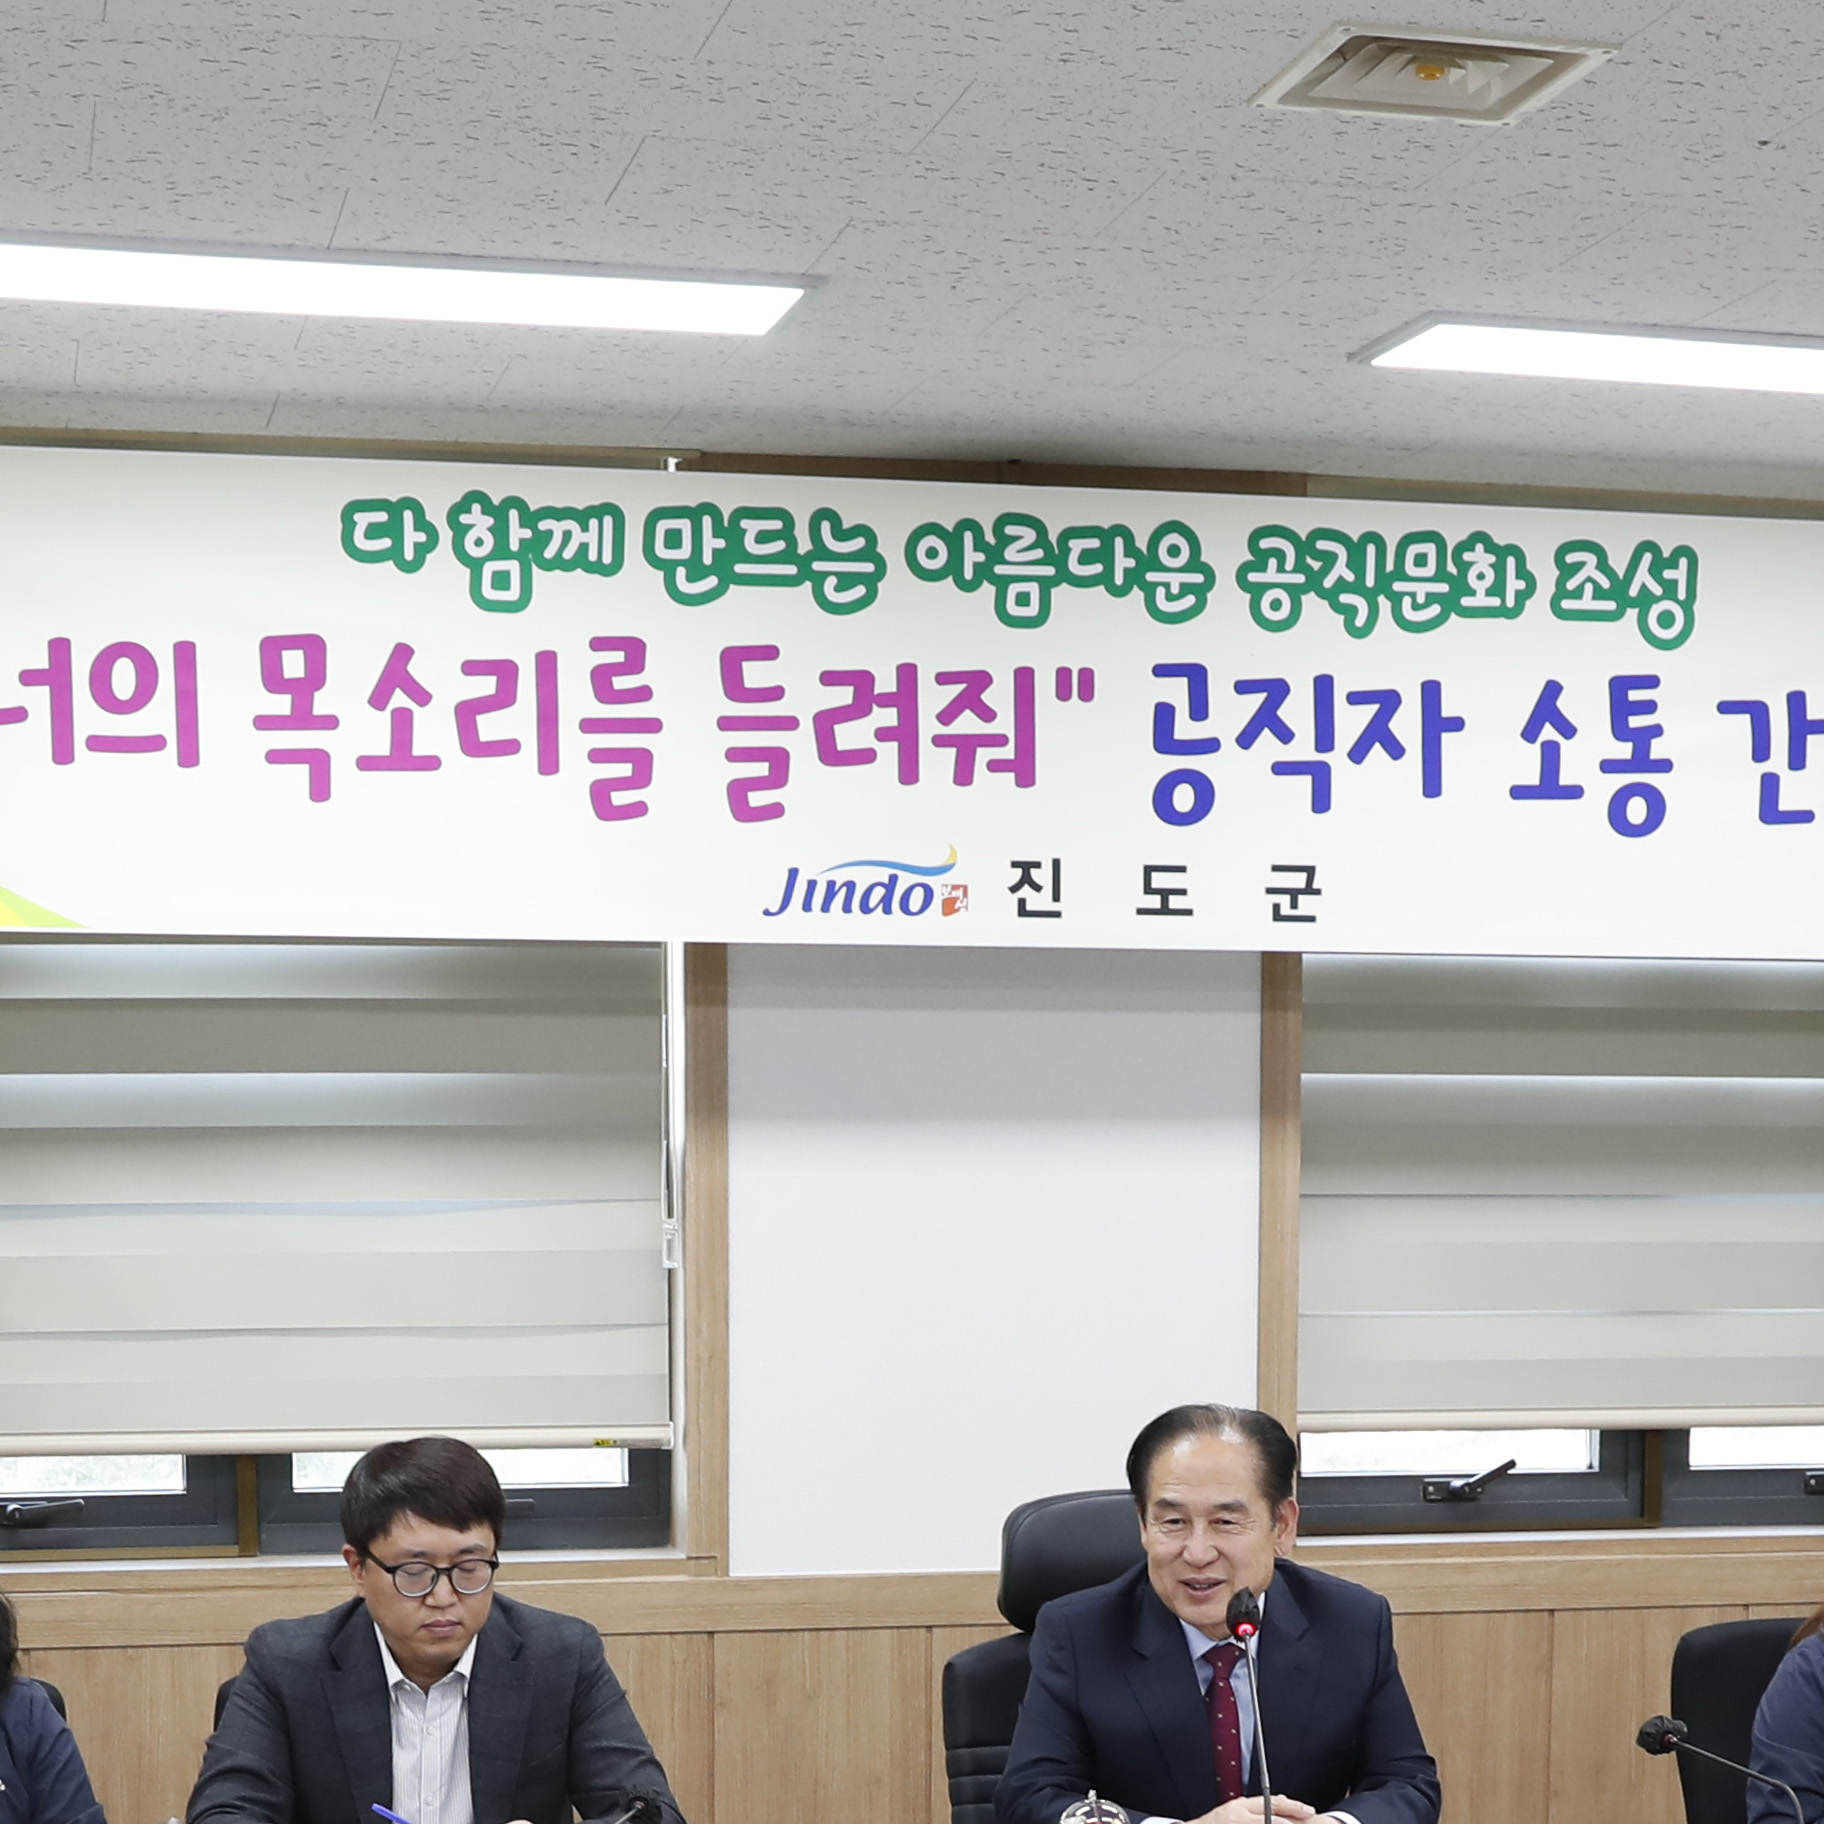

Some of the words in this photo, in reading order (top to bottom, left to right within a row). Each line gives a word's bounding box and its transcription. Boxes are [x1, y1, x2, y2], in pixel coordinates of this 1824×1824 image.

[344, 499, 436, 571] 다
[450, 493, 622, 611] 함께
[645, 504, 884, 613] 만드는
[907, 523, 1211, 627] 아름다운
[1238, 527, 1533, 637] 공직문화
[1553, 541, 1697, 649] 조성
[253, 634, 663, 821] 목소리를
[717, 644, 1094, 822] 들려줘"
[1152, 663, 1465, 826] 공직자
[1509, 674, 1673, 837] 소통
[762, 866, 934, 917] Jindo
